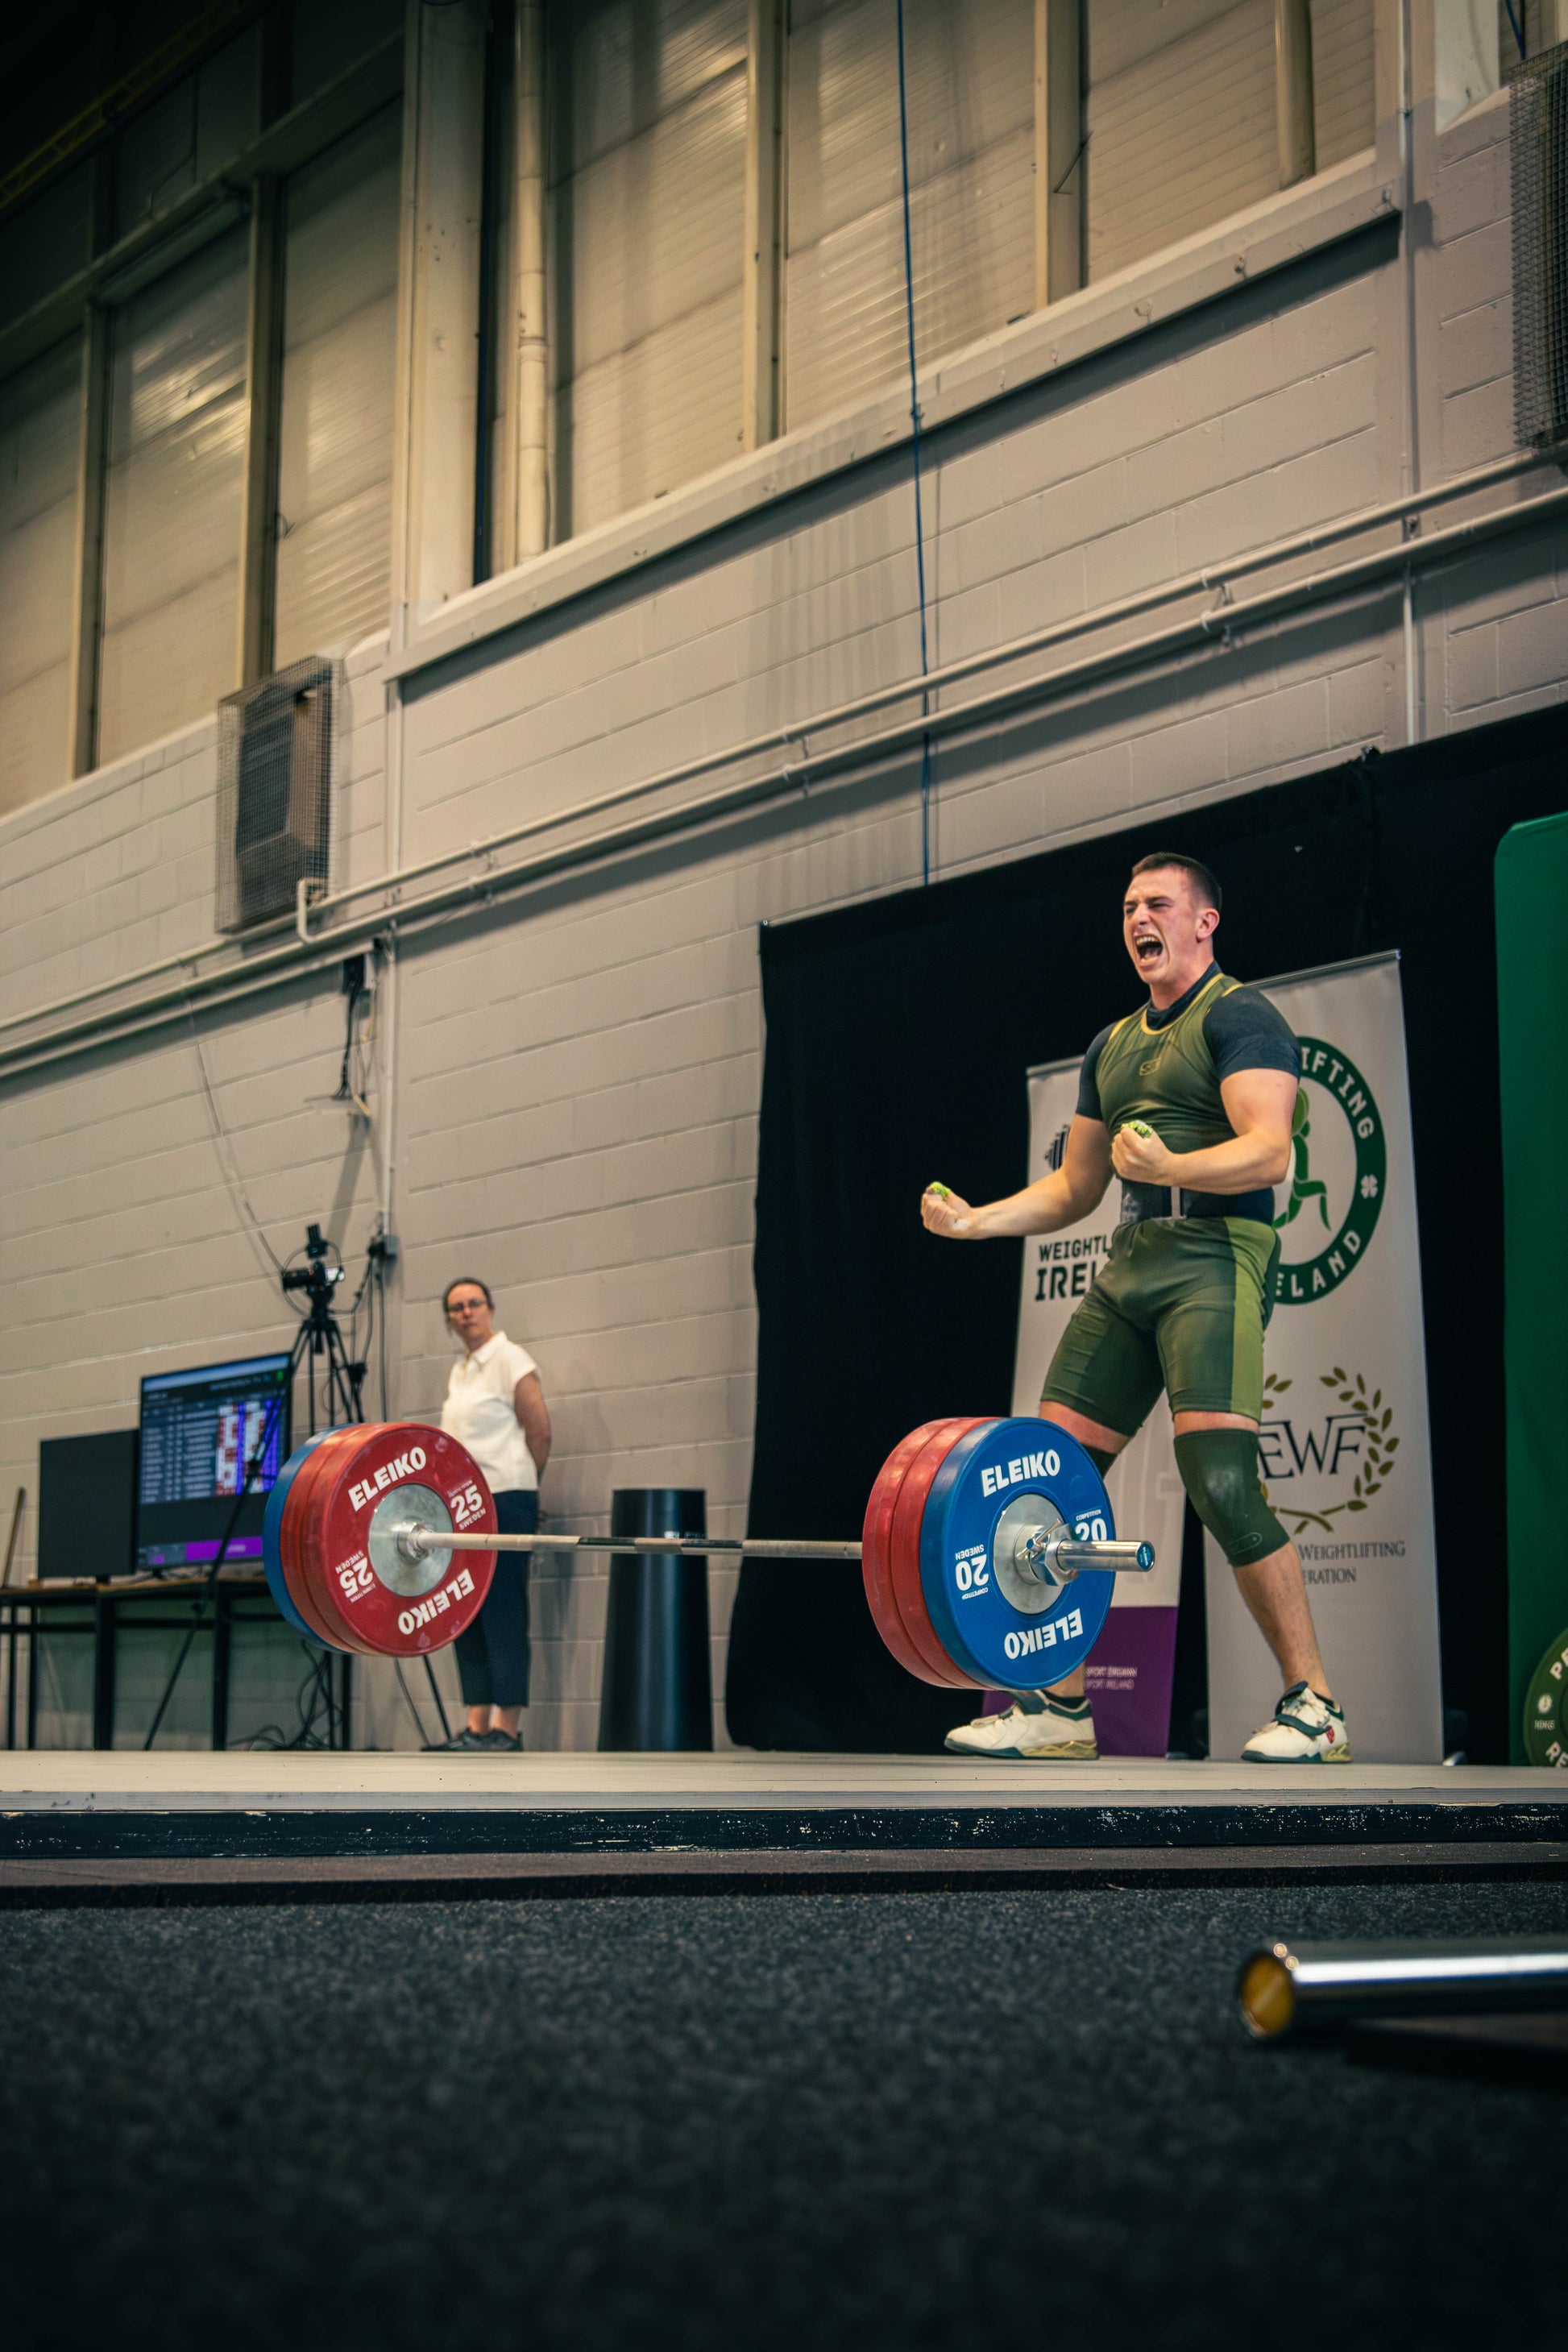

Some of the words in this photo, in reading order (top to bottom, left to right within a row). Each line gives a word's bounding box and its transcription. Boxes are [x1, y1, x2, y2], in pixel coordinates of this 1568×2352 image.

[1258, 1412, 1367, 1479] EWF
[347, 1446, 426, 1512] ELEIKO
[981, 1449, 1061, 1497] ELEIKO
[450, 1484, 483, 1524] 25
[458, 1508, 486, 1530] SWEDEN
[1075, 1518, 1107, 1541] 20
[334, 1550, 364, 1574] SWEDEN
[955, 1544, 985, 1561] SWEDEN
[1298, 1540, 1406, 1561] WEIGHTLIFTING
[339, 1557, 373, 1598] 25
[955, 1554, 989, 1591] 20
[398, 1568, 475, 1635] ELEIKO
[1004, 1607, 1083, 1660] ELEIKO
